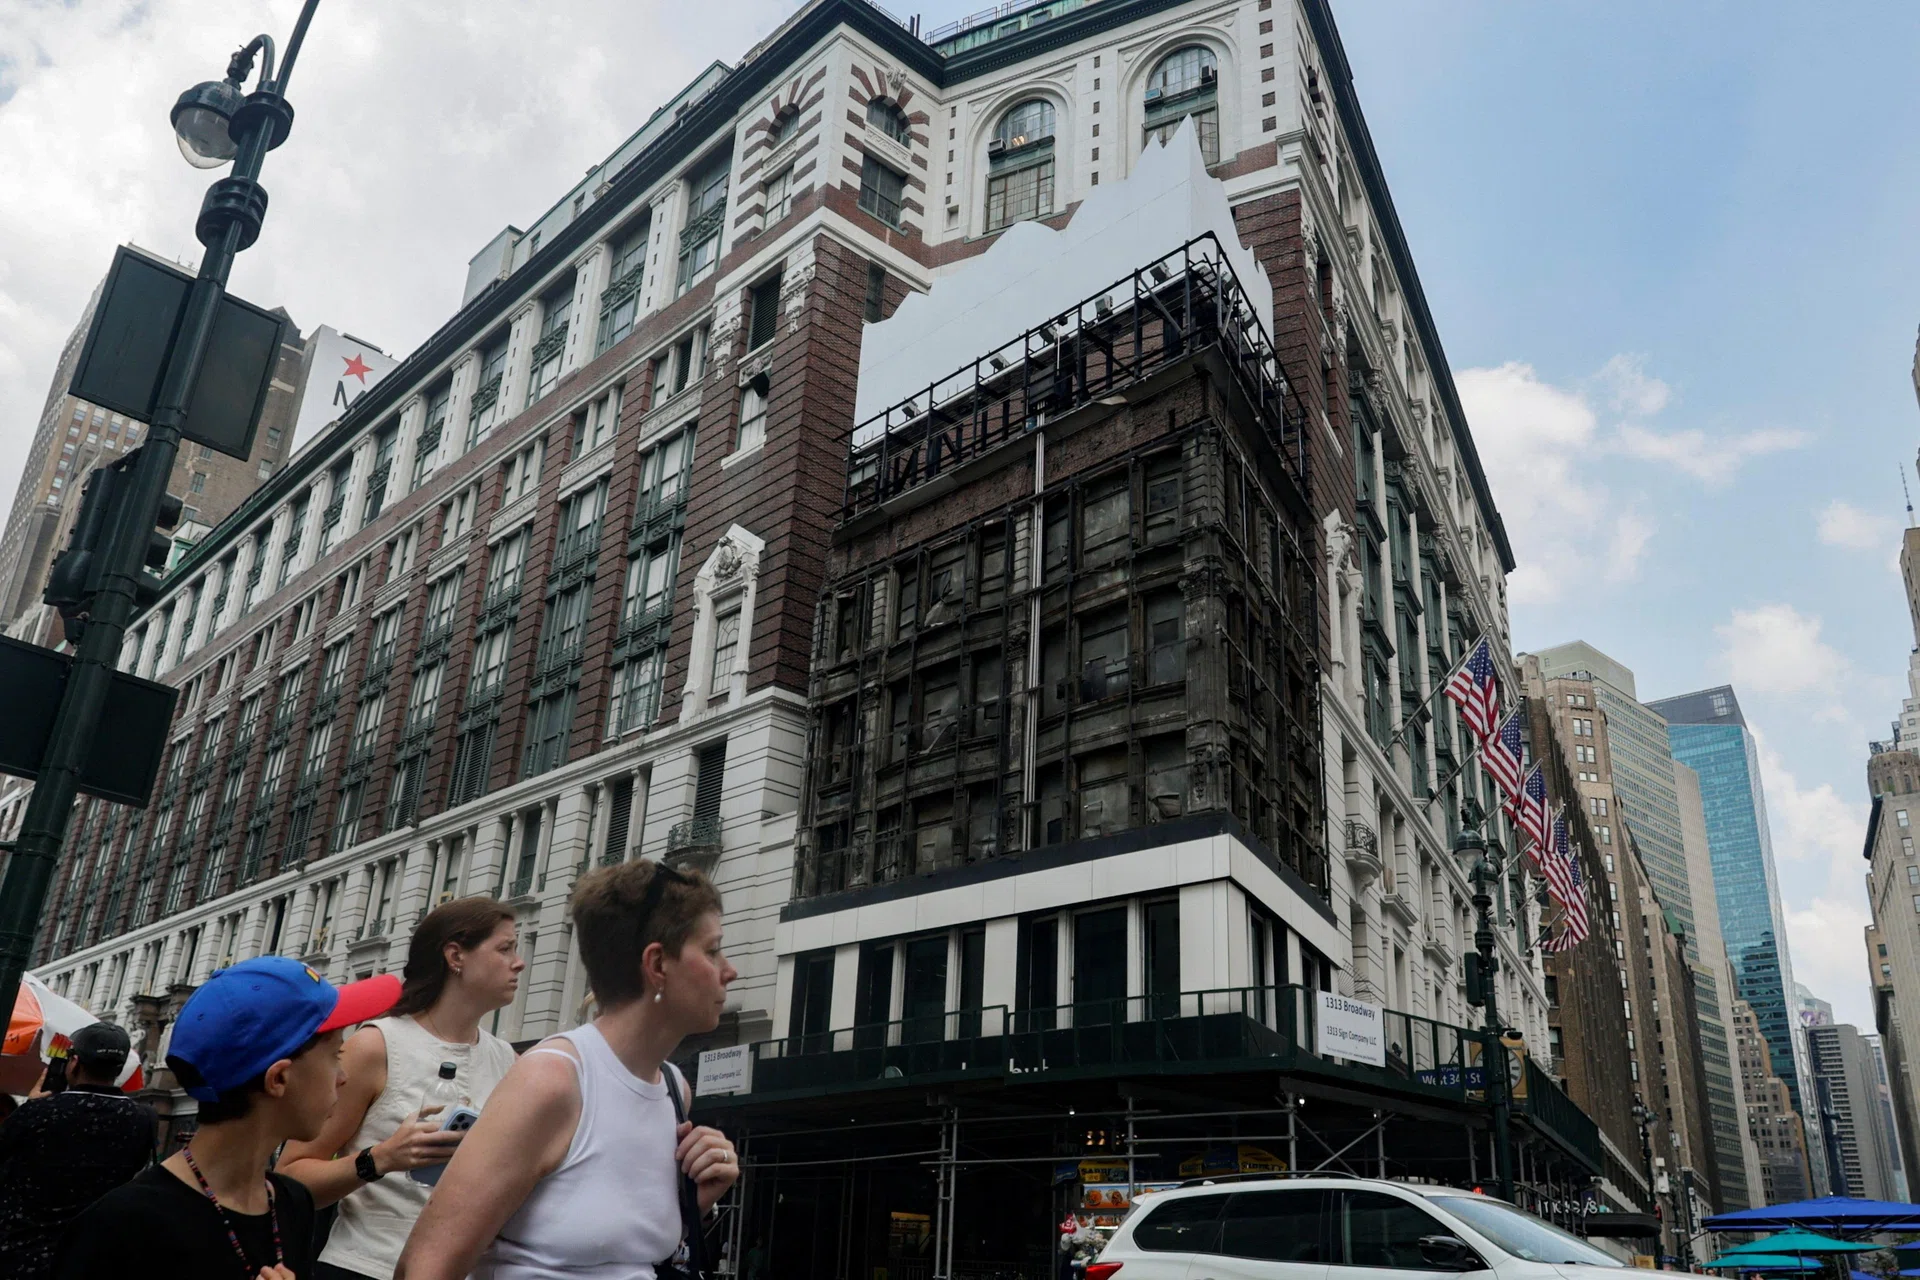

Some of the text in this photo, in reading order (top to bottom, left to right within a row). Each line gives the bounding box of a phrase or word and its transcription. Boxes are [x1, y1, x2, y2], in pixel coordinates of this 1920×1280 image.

[1326, 997, 1375, 1021] 1313 Broadway
[1327, 1025, 1377, 1046] 1313 Sign Company LLC
[717, 1049, 742, 1061] Broadway
[1470, 1072, 1481, 1084] St
